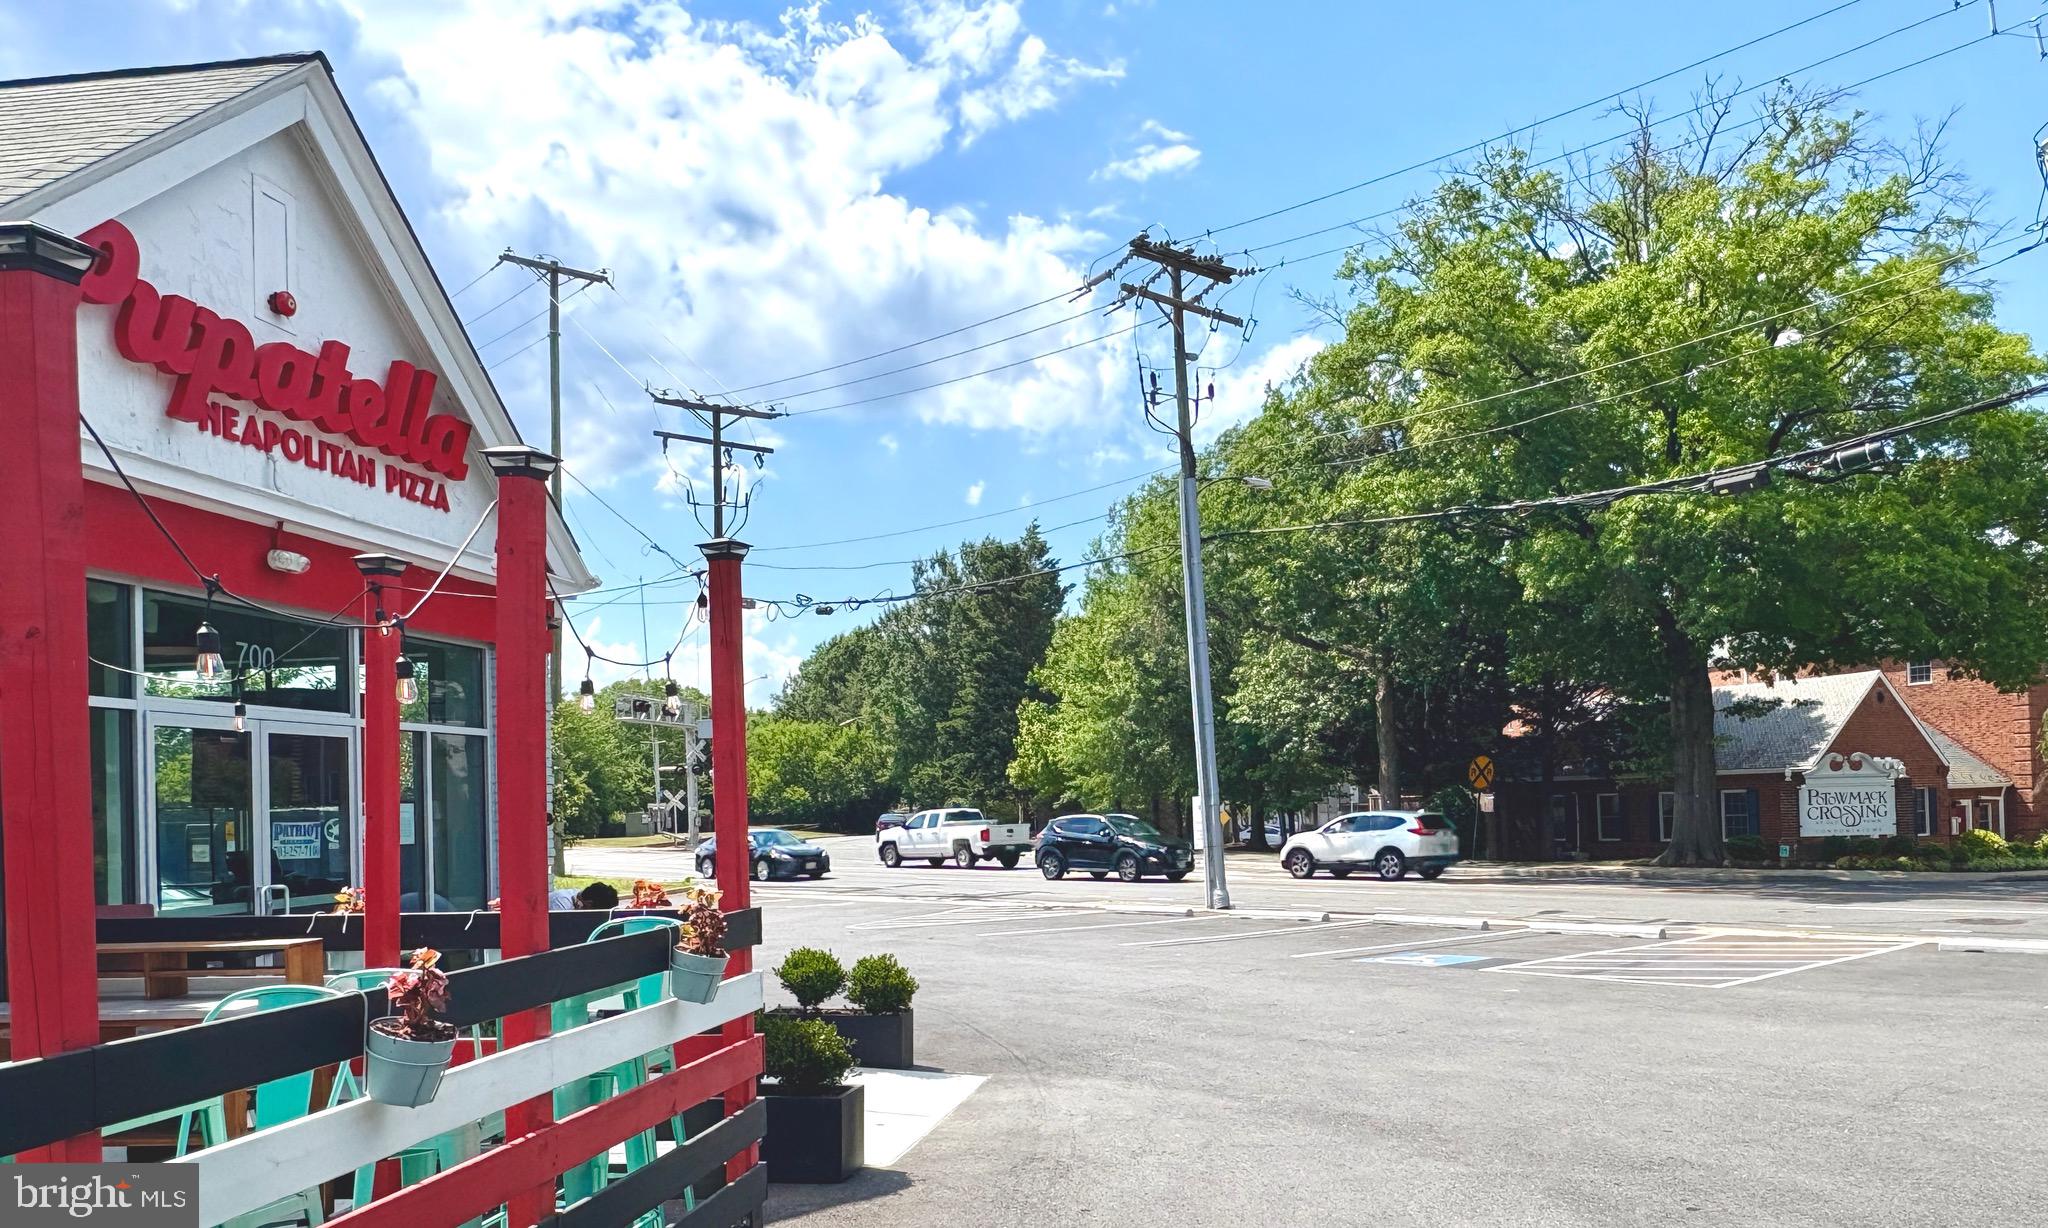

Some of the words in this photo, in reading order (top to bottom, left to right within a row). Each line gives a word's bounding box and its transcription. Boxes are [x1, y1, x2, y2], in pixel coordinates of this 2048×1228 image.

[199, 401, 376, 488] NEAPOLITAN
[385, 464, 451, 513] PIZZA
[235, 641, 275, 673] 700
[1807, 803, 1888, 827] CROSSING
[274, 823, 320, 840] PATRIOT
